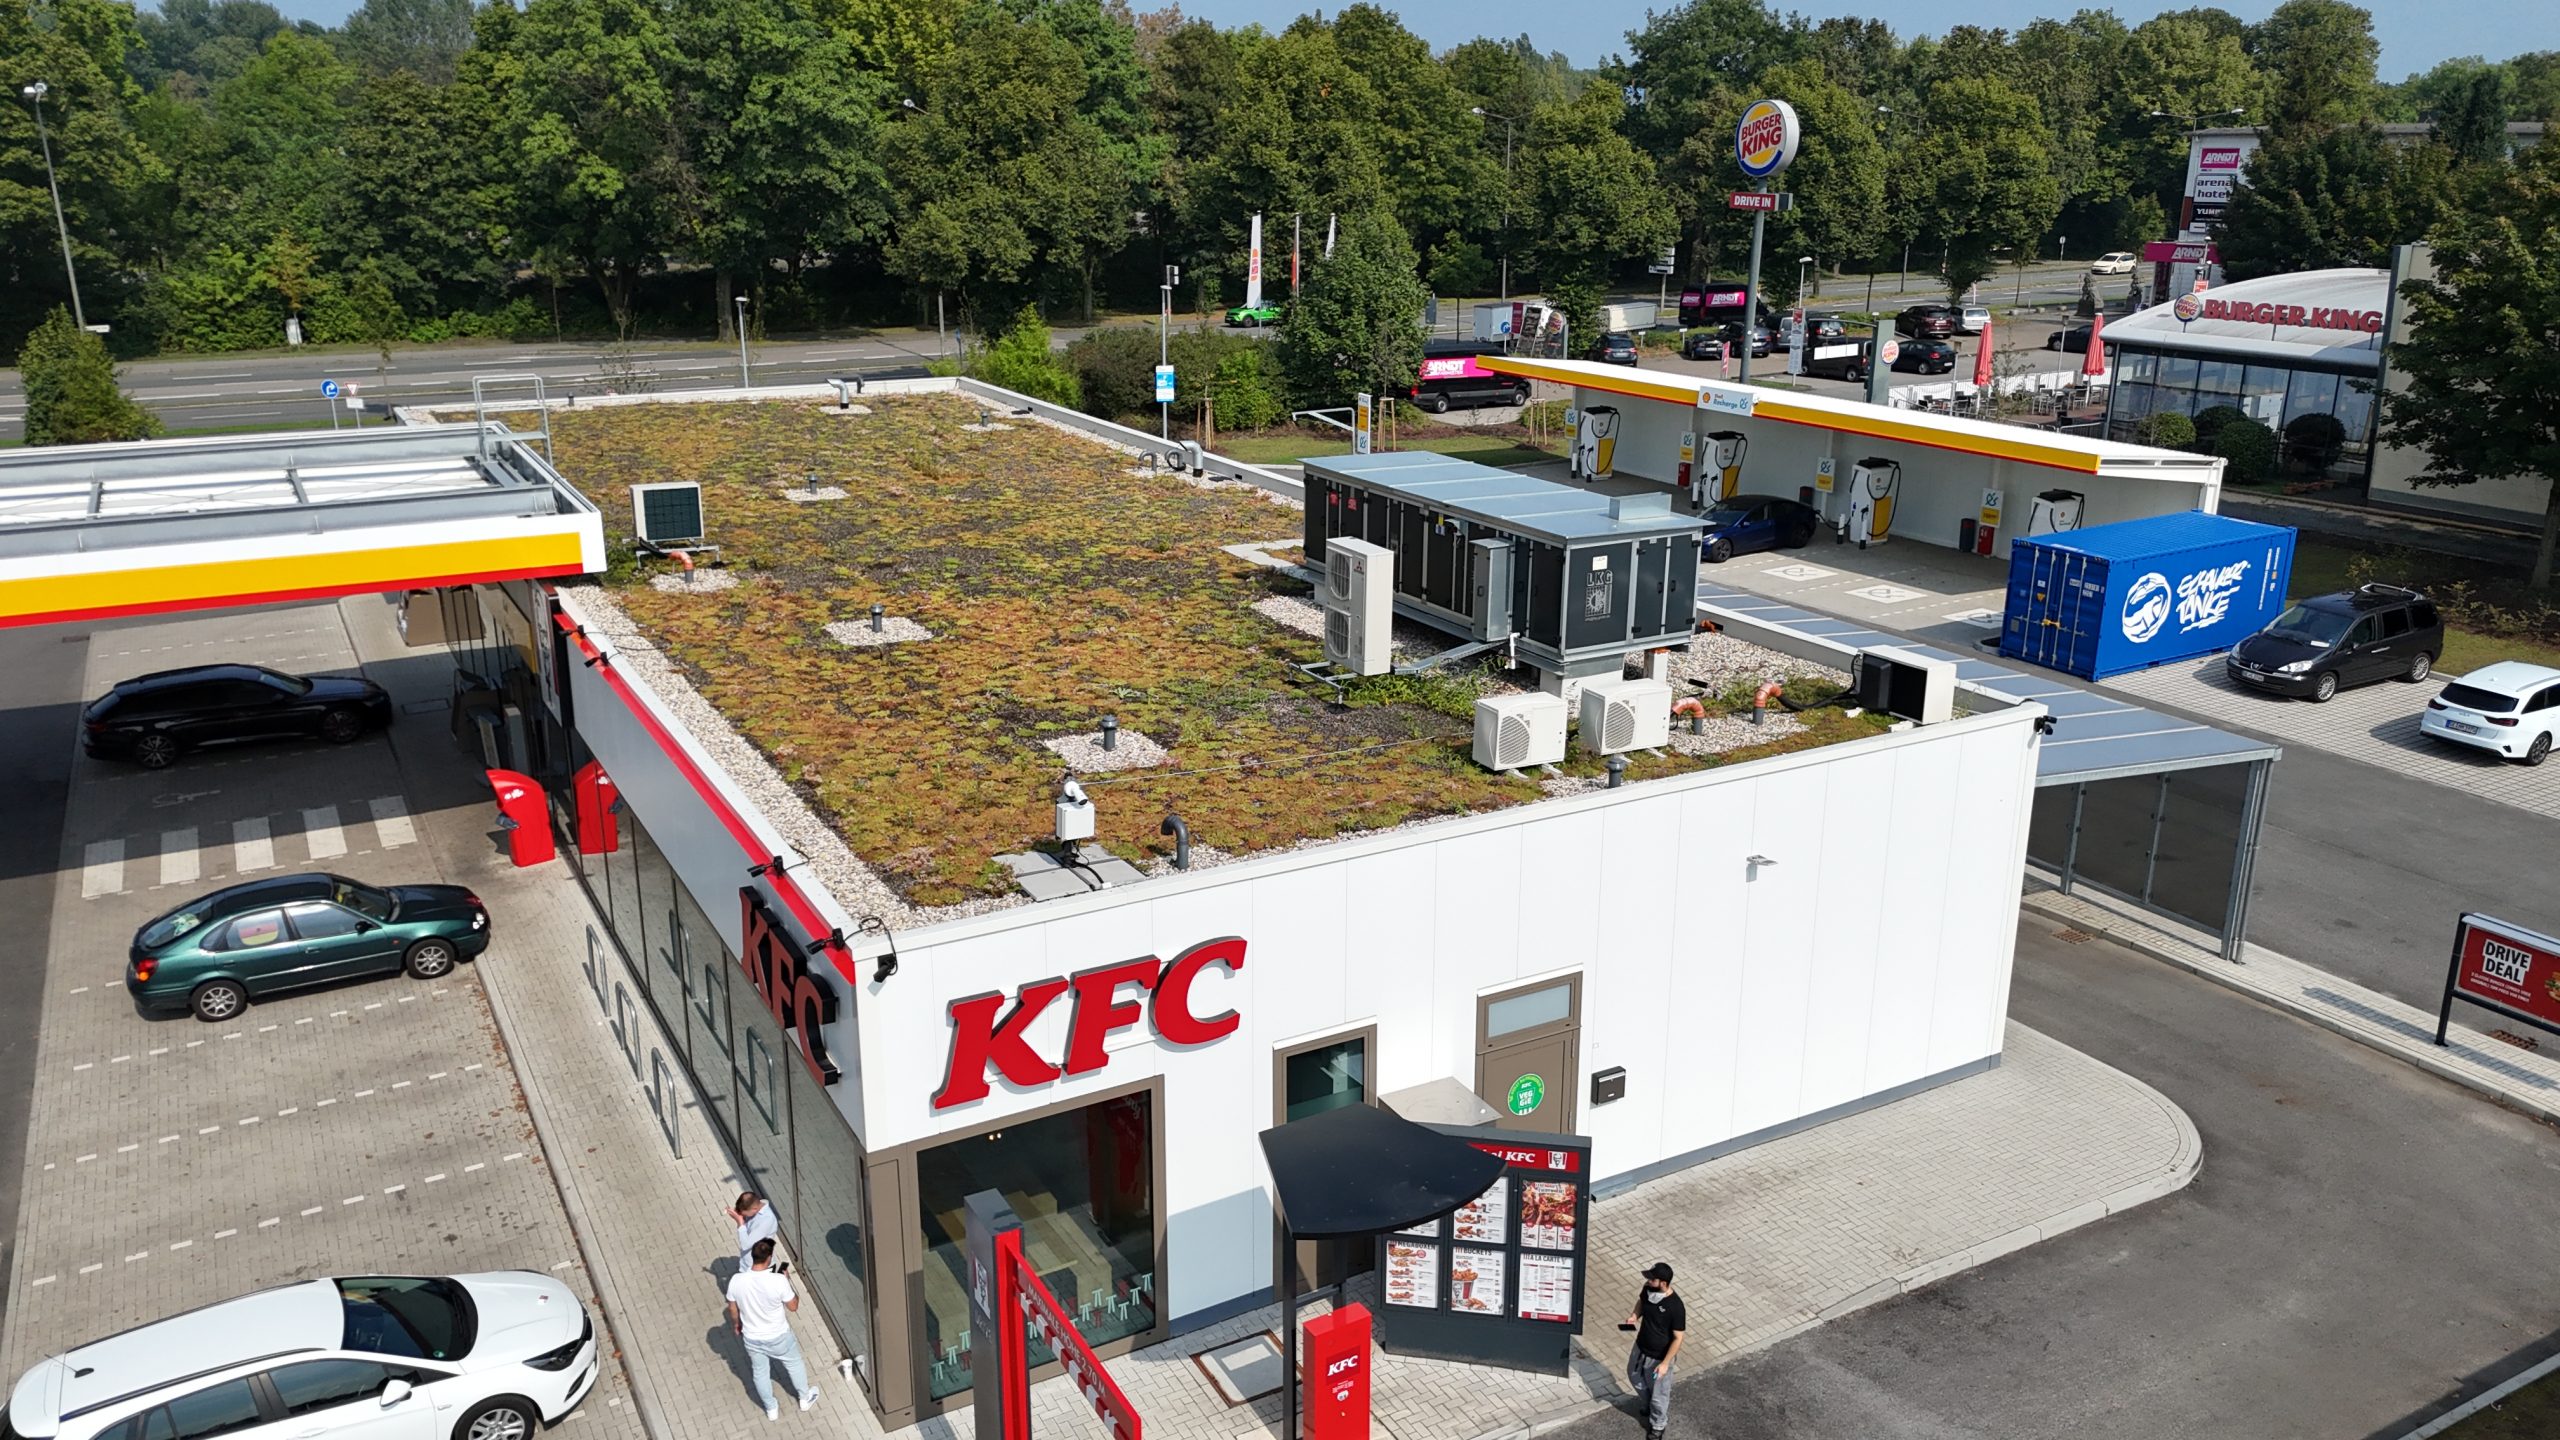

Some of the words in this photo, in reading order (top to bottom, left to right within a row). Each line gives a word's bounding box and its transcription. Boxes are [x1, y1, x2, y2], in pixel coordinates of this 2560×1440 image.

[1741, 113, 1782, 141] BURGER
[1741, 126, 1782, 160] KING
[2202, 152, 2238, 164] ARNDT
[1734, 195, 1760, 207] DRIVE
[1761, 196, 1771, 207] IN
[1711, 292, 1740, 305] ARNDT
[2203, 299, 2306, 328] BURGER
[2310, 307, 2384, 333] KING
[1427, 360, 1465, 376] ARNDT
[1713, 398, 1738, 409] Recharge
[1586, 569, 1613, 587] LKG
[2484, 941, 2530, 969] DRIVE
[2484, 958, 2521, 983] DEAL
[738, 885, 843, 1088] KFC
[930, 935, 1248, 1111] KFC
[1505, 1151, 1535, 1163] KFC
[1463, 1246, 1493, 1257] BUCKETS
[1327, 1354, 1359, 1377] KFC
